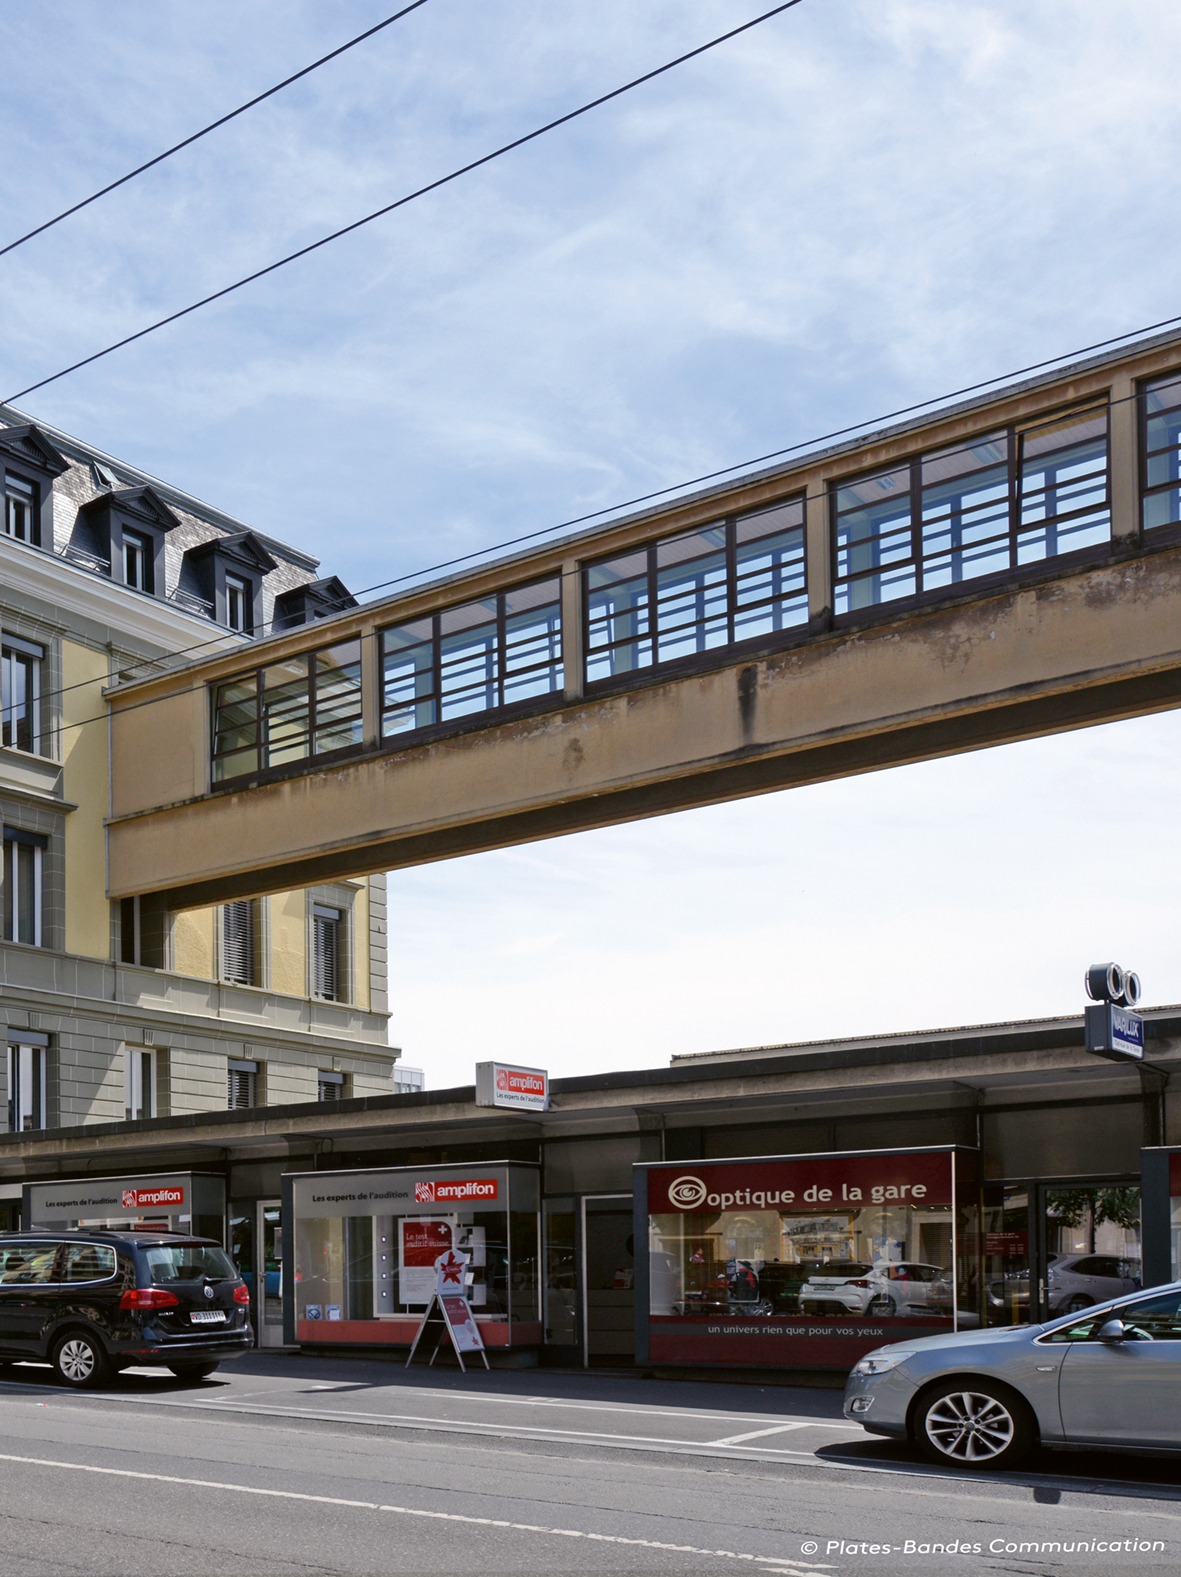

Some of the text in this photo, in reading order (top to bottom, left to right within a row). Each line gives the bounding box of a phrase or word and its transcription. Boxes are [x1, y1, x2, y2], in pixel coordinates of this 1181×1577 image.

[1113, 1014, 1139, 1037] VARILUX
[510, 1076, 543, 1091] amplifon
[504, 1093, 519, 1101] experts
[138, 1190, 181, 1204] amplifon
[326, 1193, 356, 1203] experts
[357, 1192, 368, 1200] de
[369, 1191, 408, 1200] l'audition
[437, 1182, 494, 1198] amplifon
[707, 1183, 927, 1210] optique de la gare
[56, 1200, 78, 1208] experts
[88, 1197, 117, 1205] l'audition
[723, 1325, 759, 1334] univers
[762, 1325, 783, 1334] rien
[786, 1327, 806, 1336] que
[808, 1327, 833, 1336] pour
[836, 1328, 854, 1336] vos
[857, 1327, 883, 1337] yeux
